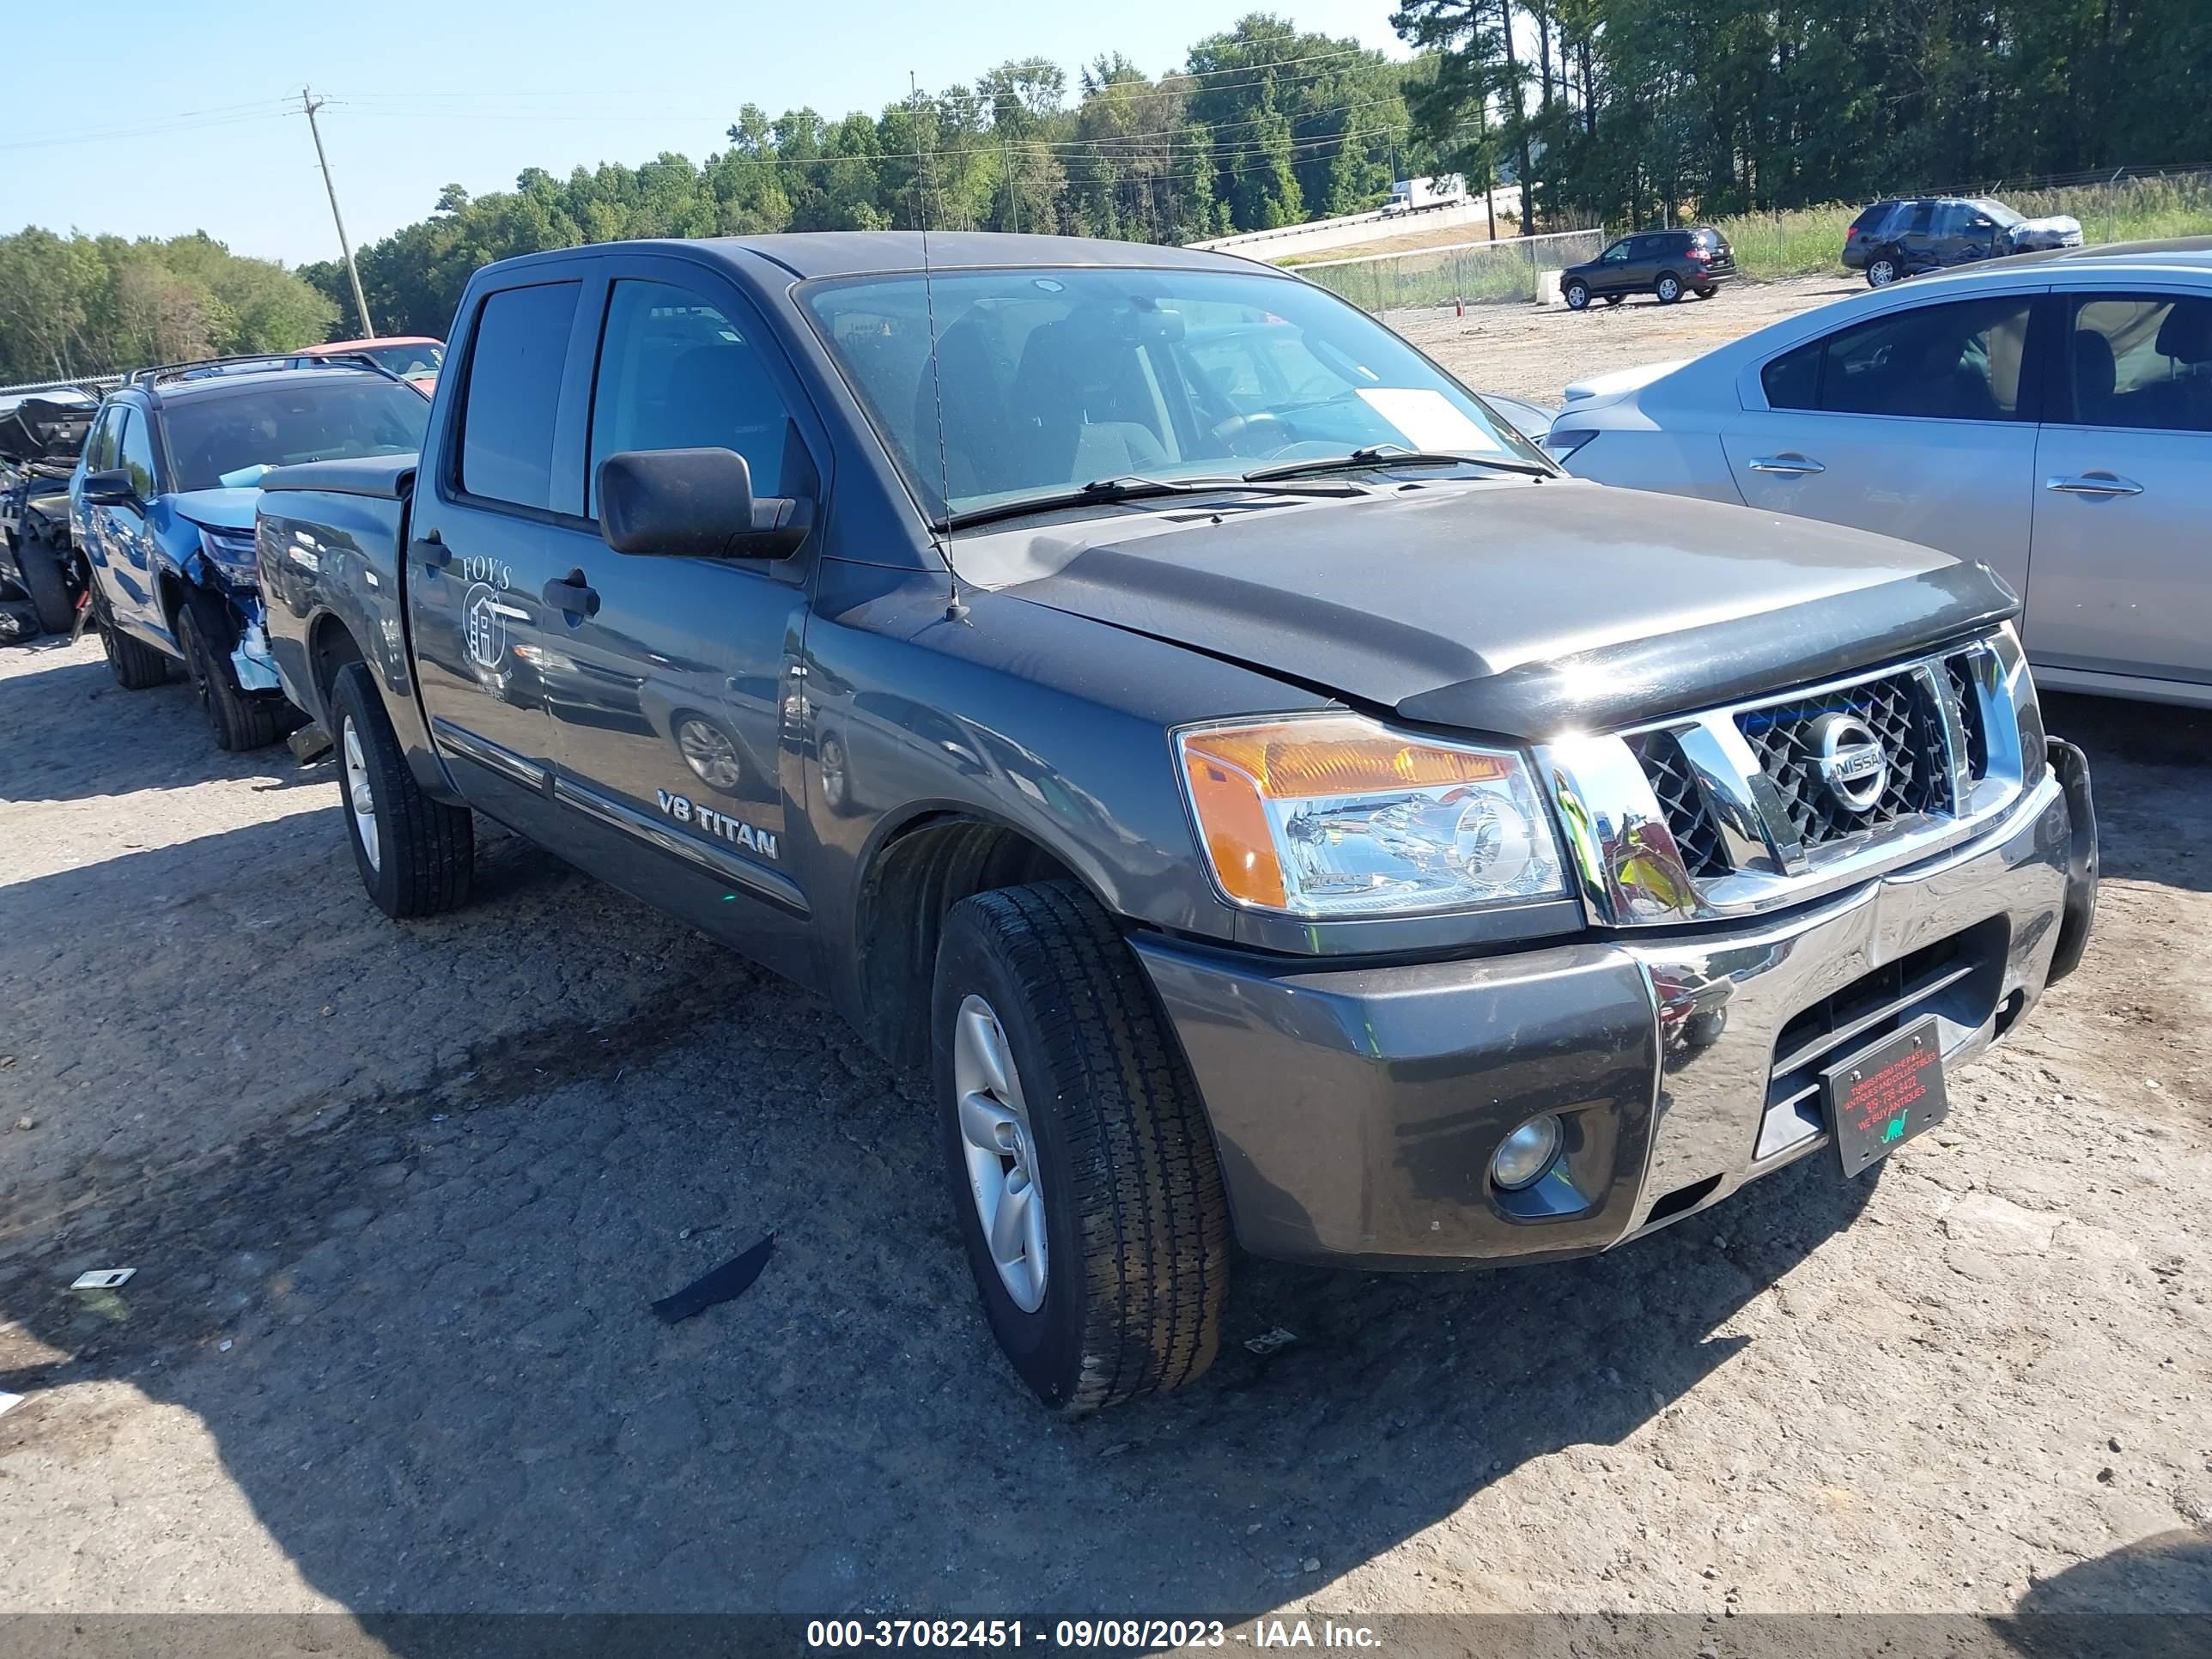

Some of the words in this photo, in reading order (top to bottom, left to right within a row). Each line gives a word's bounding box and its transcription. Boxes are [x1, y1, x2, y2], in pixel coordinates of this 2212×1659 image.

[463, 555, 513, 590] FOY'S
[1835, 750, 1887, 775] NISSAN
[657, 788, 695, 822] V8
[696, 804, 780, 860] TITAN
[1844, 1085, 1879, 1110] ANTIQUES
[1879, 1078, 1893, 1091] AND
[1892, 1052, 1937, 1083] COLLECTIBLES
[1850, 1077, 1875, 1096] THINGS
[1875, 1066, 1894, 1082] FROM
[1894, 1058, 1907, 1071] THE
[1906, 1048, 1923, 1066] PAST
[1857, 1117, 1872, 1130] WE
[1872, 1107, 1888, 1123] BUY
[1888, 1085, 1927, 1111] ANTIQUES
